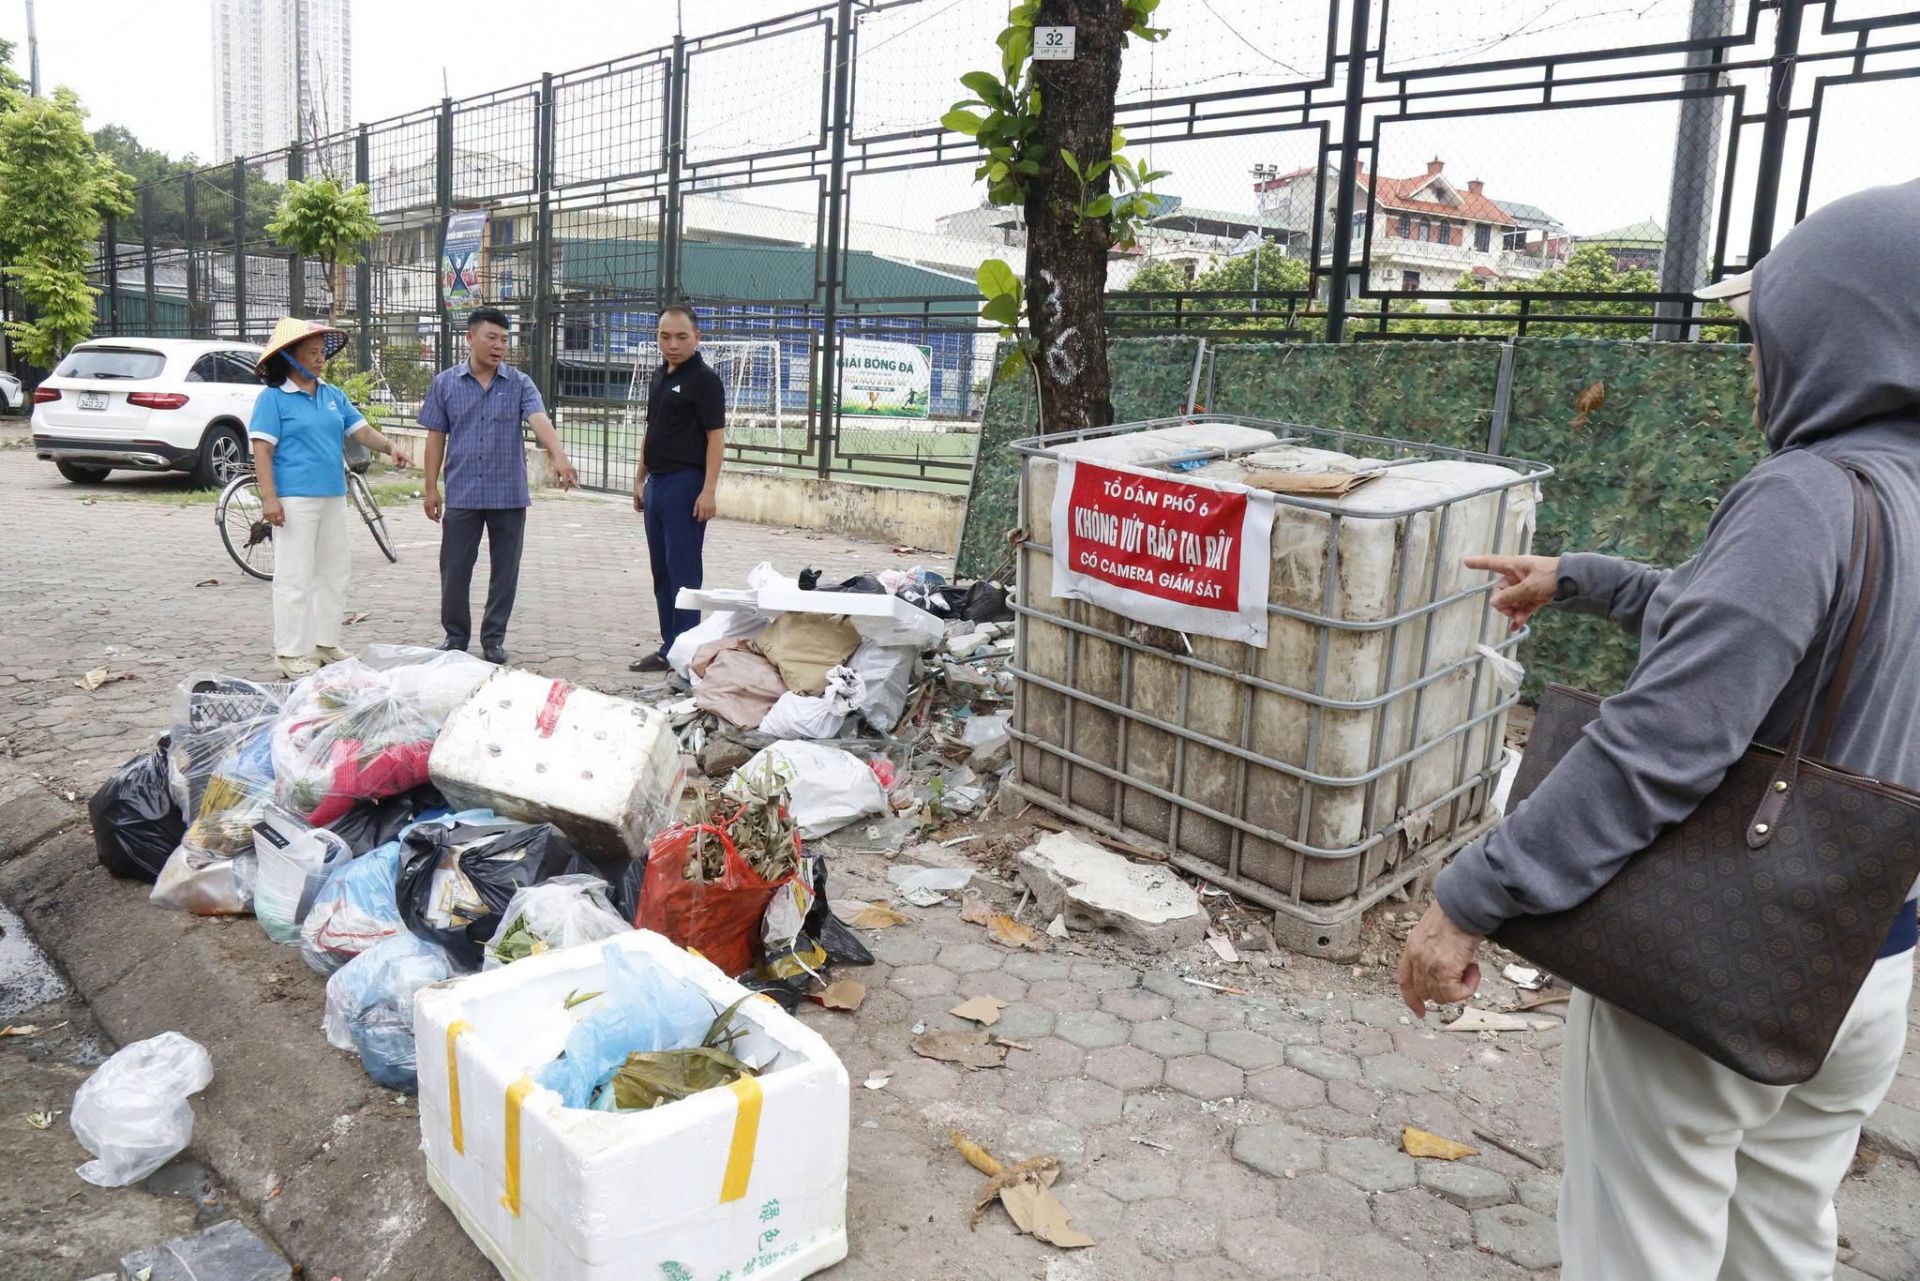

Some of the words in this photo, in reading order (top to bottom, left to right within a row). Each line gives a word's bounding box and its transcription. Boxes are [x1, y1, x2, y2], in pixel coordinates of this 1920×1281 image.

[1046, 32, 1064, 46] 32
[864, 355, 897, 371] BÓNG
[898, 361, 914, 375] ĐÁ
[1104, 476, 1122, 497] TỔ
[1124, 485, 1158, 506] DÂN
[1162, 493, 1197, 513] PHỐ
[1199, 502, 1209, 517] 6
[1075, 504, 1119, 547] KHÔNG
[1120, 512, 1144, 554] VỨT
[1147, 520, 1178, 561] RÁC
[1180, 530, 1202, 572] TẠI
[1205, 529, 1233, 571] ĐÂY
[1080, 551, 1098, 568] CÓ
[1100, 559, 1154, 585] CAMERA
[1159, 573, 1195, 594] GIÁM
[1196, 580, 1222, 599] SÁT
